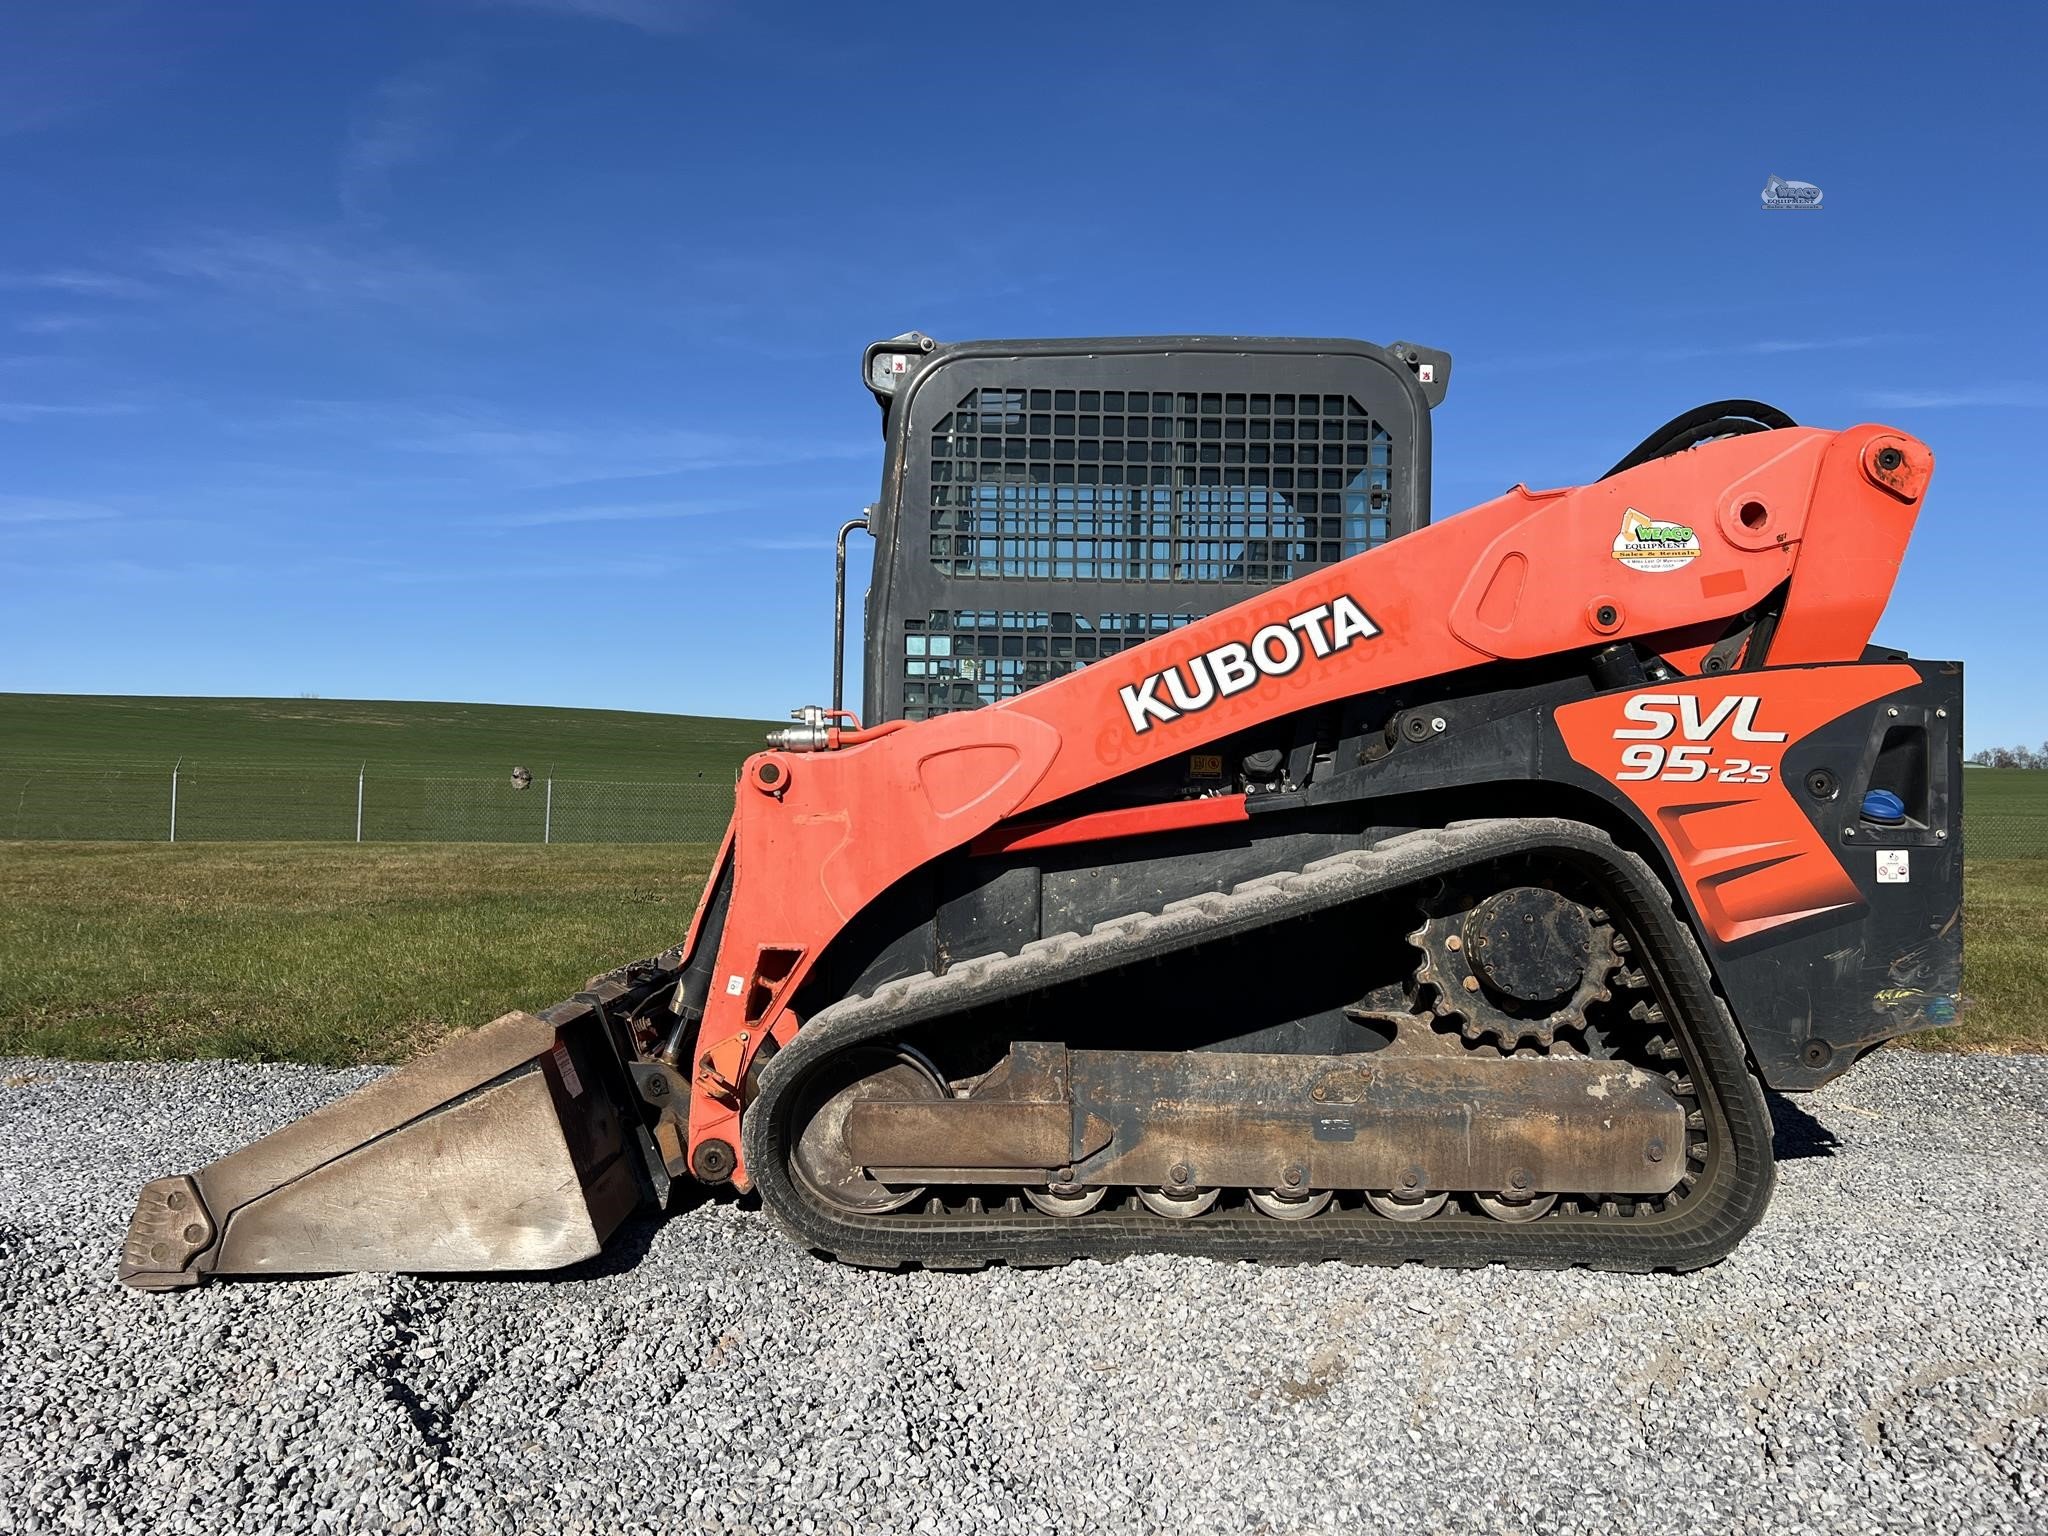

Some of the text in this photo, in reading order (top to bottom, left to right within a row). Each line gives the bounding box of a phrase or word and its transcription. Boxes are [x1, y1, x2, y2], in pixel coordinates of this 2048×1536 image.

[1635, 525, 1693, 543] WEACO
[1118, 594, 1382, 734] KUBOTA
[1612, 694, 1789, 743] SVL
